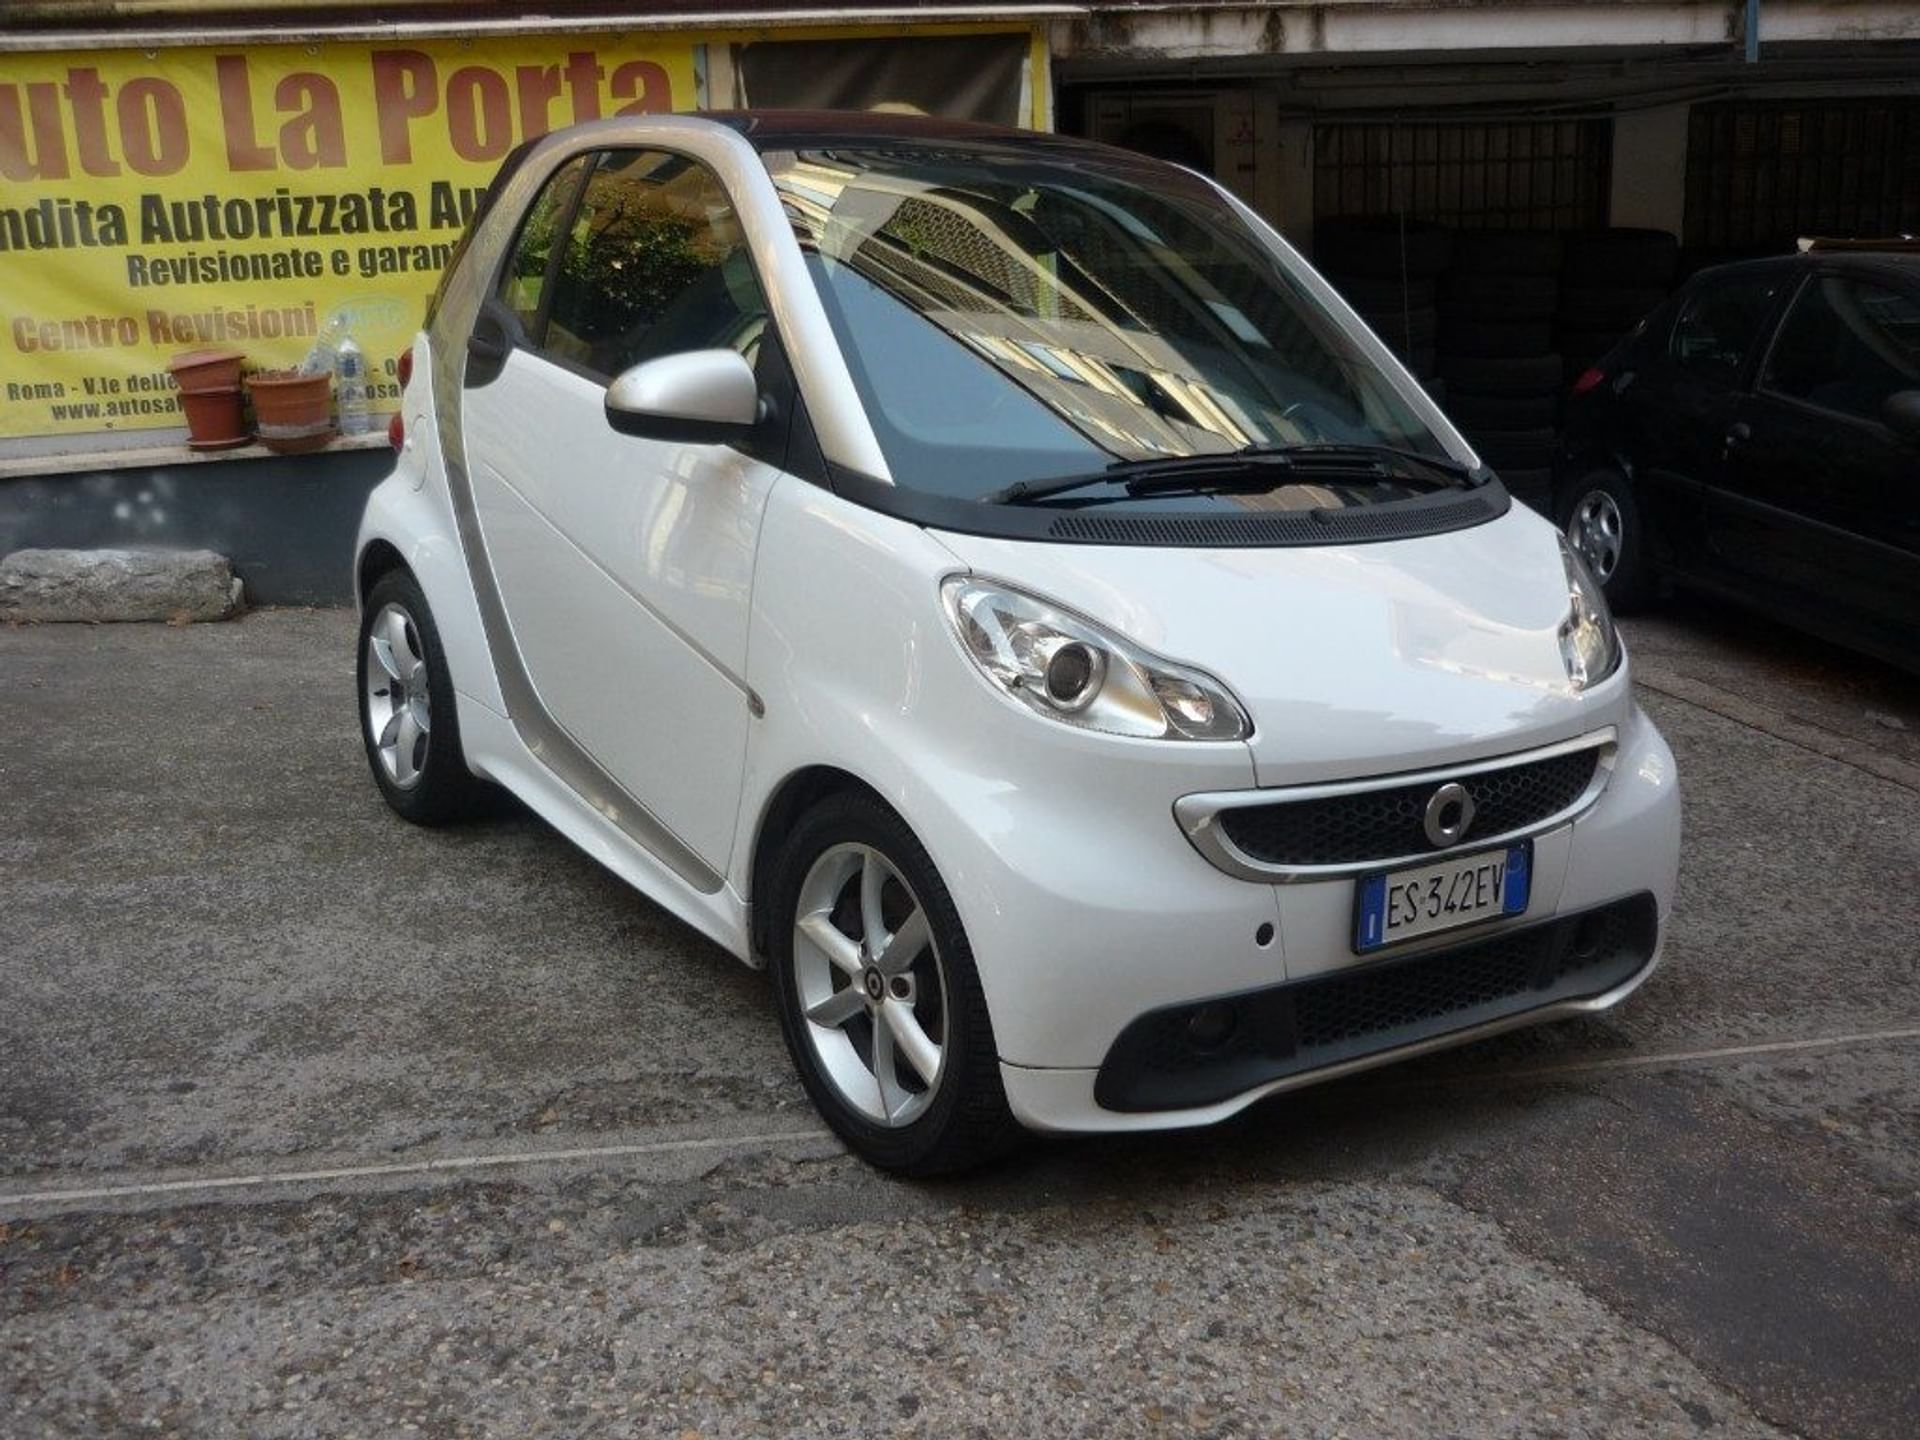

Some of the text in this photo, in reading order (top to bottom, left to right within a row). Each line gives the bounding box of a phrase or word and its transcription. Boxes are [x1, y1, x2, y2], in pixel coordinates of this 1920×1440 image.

[216, 55, 346, 172] La
[372, 51, 672, 165] Porta
[141, 188, 418, 244] Autorizzata
[126, 249, 323, 287] Revisionate
[331, 249, 350, 276] e
[12, 314, 141, 353] Centro
[146, 301, 317, 345] Revisioni
[7, 382, 65, 401] Roma
[83, 372, 120, 396] V.le
[127, 372, 178, 392] delle
